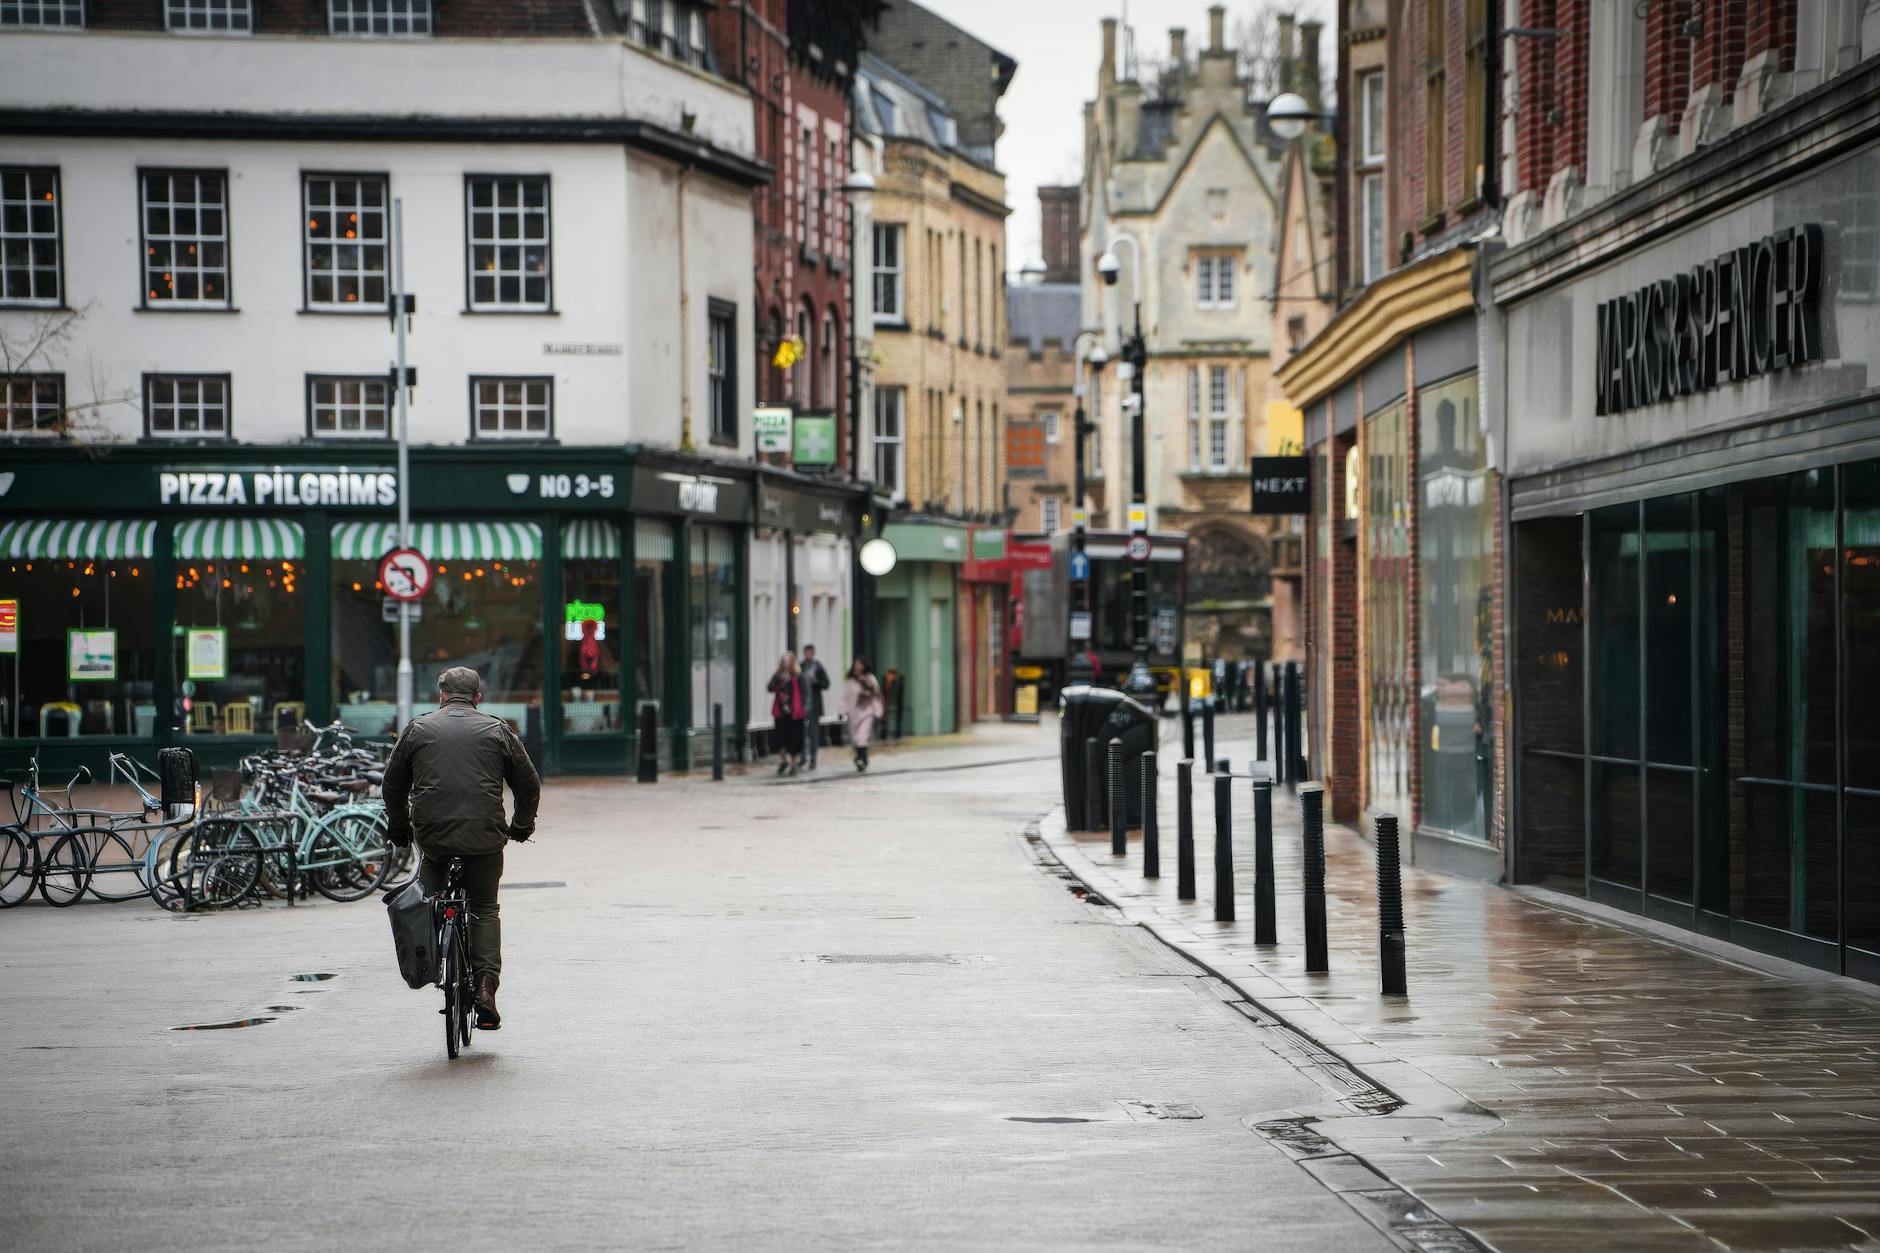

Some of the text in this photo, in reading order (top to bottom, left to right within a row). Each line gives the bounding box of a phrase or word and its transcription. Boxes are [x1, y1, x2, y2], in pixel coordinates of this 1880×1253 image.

[160, 473, 247, 505] PIZZA
[539, 474, 615, 499] NO 3-5
[1254, 477, 1306, 493] NEXT
